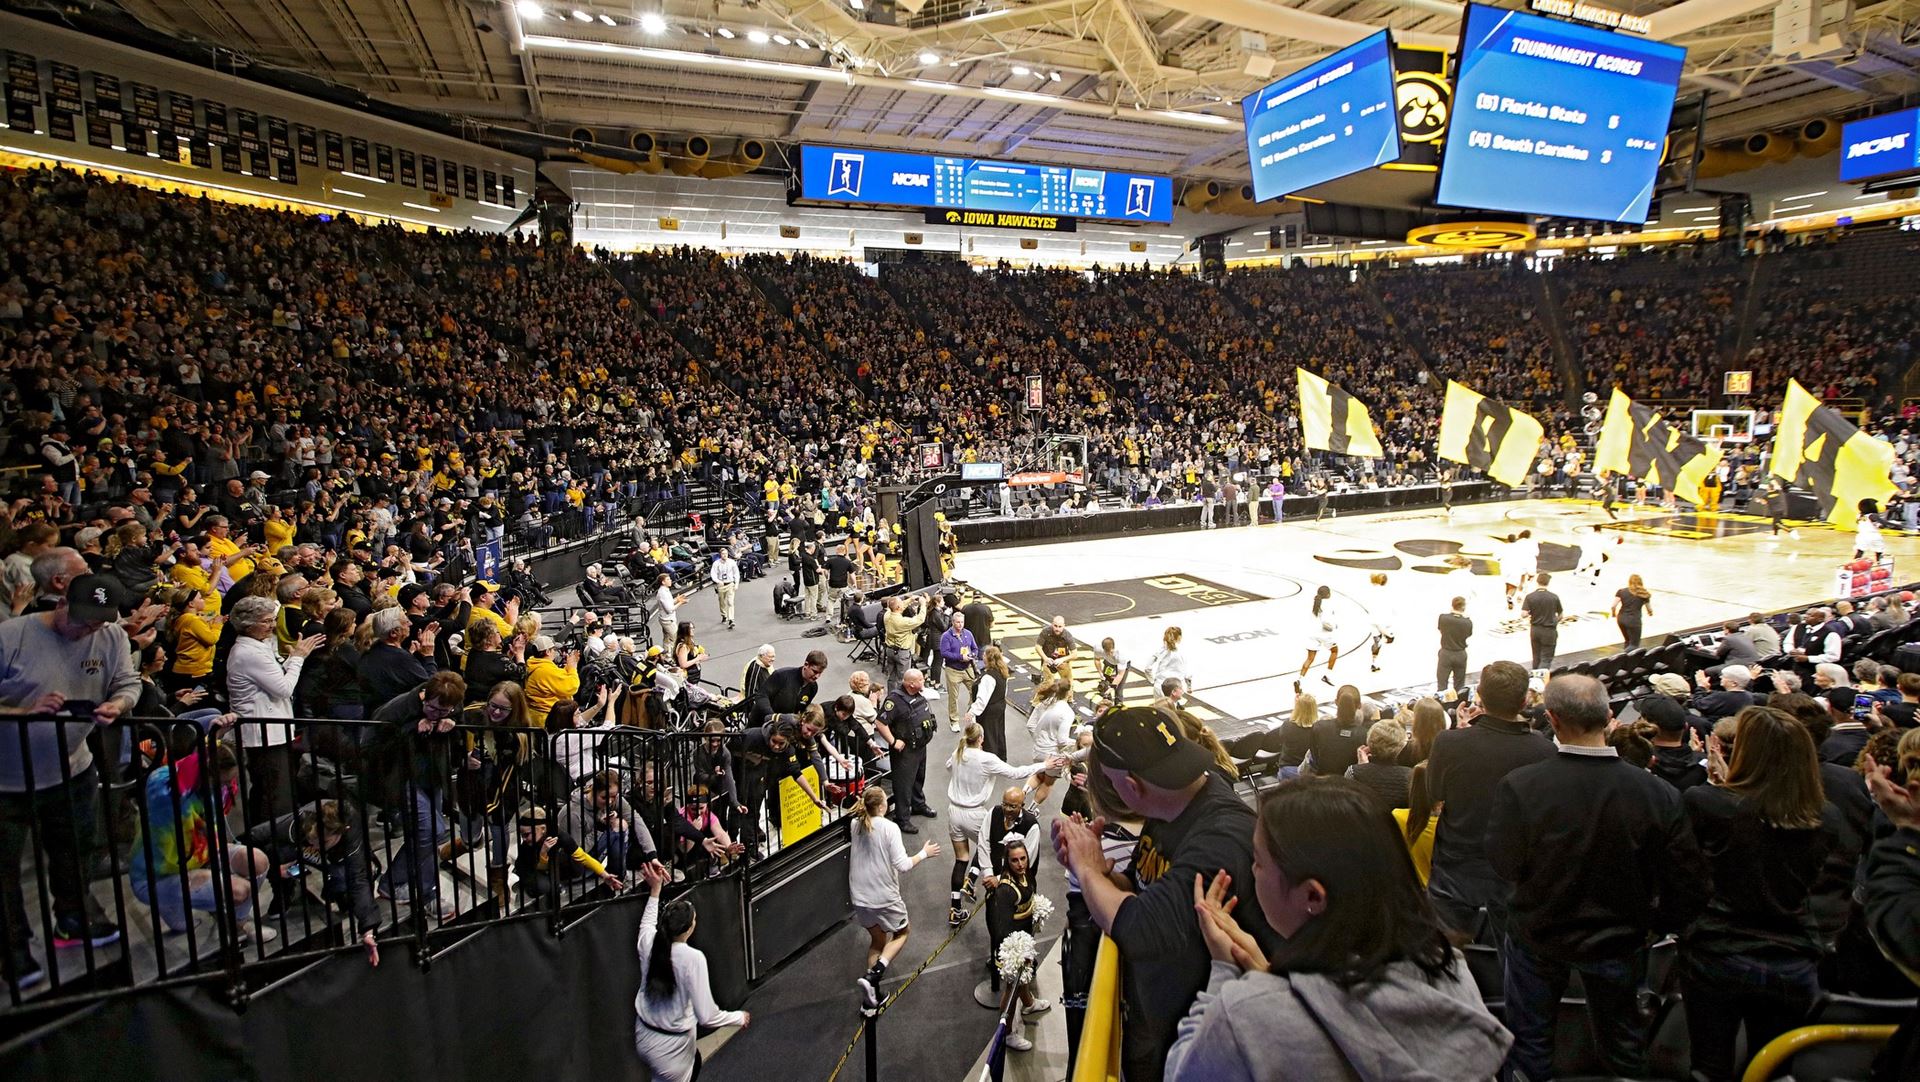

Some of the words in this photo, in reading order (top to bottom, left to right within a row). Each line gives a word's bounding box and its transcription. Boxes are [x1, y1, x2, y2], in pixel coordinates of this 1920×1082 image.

[1511, 37, 1597, 67] TOURNAMENT
[1594, 54, 1643, 76] SCORES
[1500, 97, 1548, 119] Florida
[1549, 105, 1587, 125] State
[1493, 135, 1534, 154] South
[1535, 141, 1588, 161] Carolina
[1846, 132, 1909, 159] NCAA
[892, 172, 930, 187] NCAA
[963, 212, 994, 225] IOWA
[997, 214, 1057, 229] HAWKEYES
[1326, 383, 1353, 454] I
[1466, 397, 1513, 471] O
[1793, 405, 1858, 522] A
[80, 659, 105, 669] IOWA
[1156, 721, 1177, 746] I
